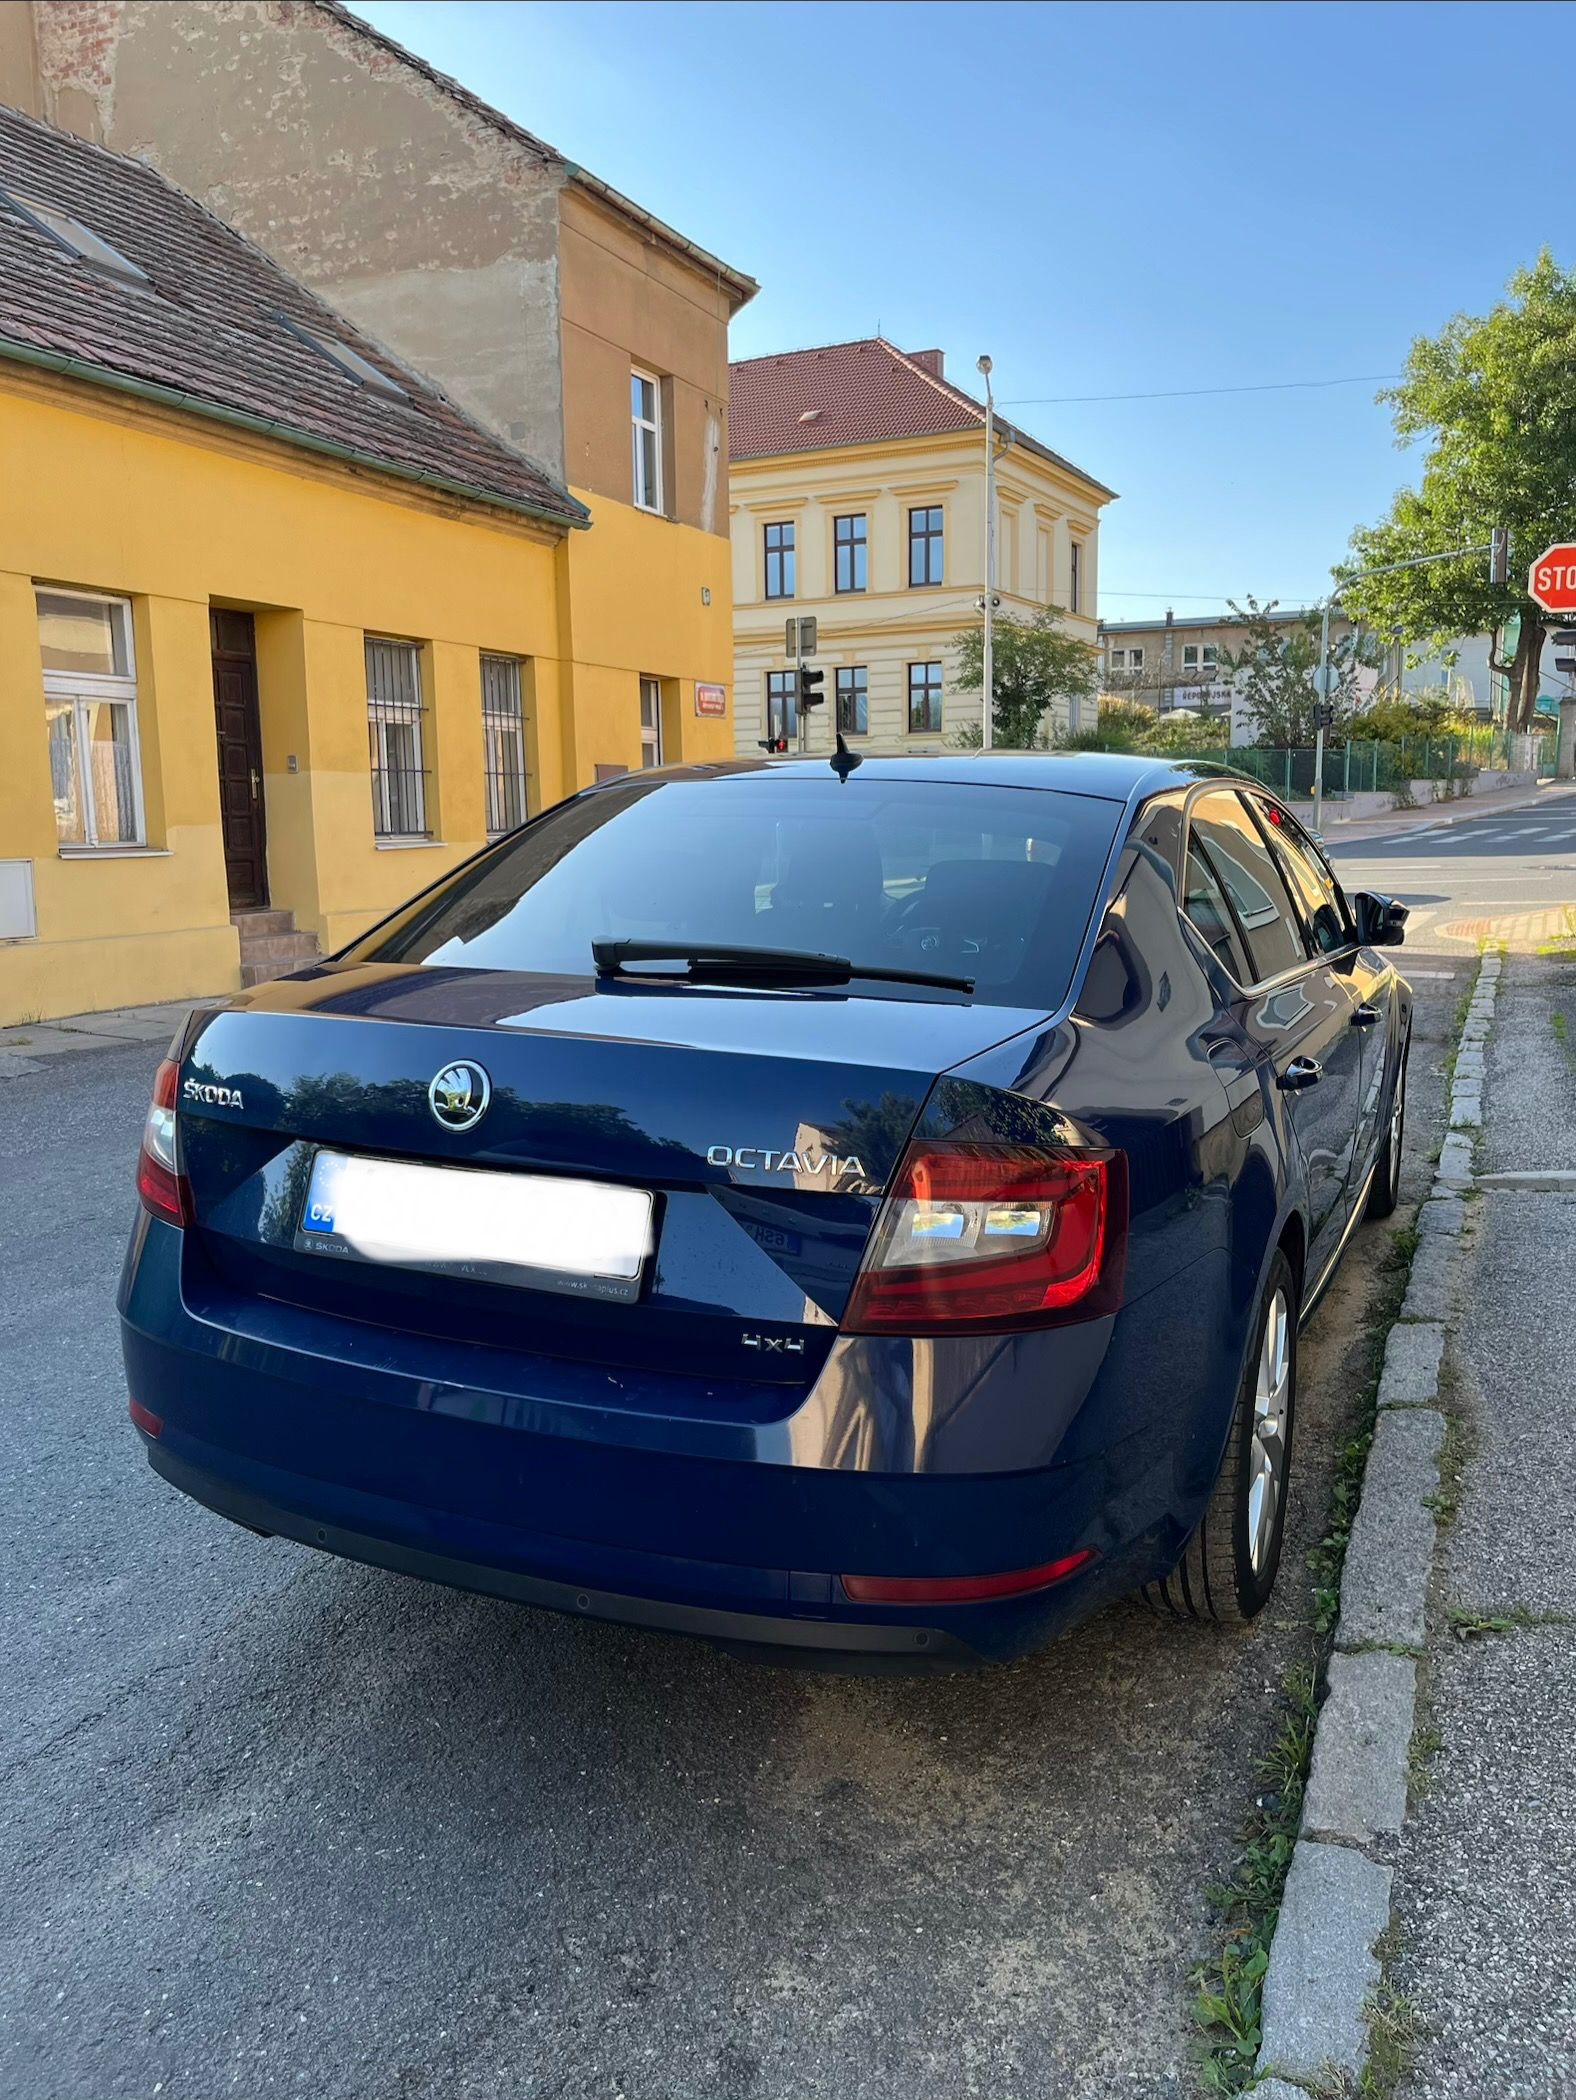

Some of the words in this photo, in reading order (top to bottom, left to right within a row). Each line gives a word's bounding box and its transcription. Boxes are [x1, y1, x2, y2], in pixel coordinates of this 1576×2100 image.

[183, 1078, 244, 1109] ŠKODA
[707, 1145, 866, 1177] OCTAVIA
[310, 1203, 333, 1223] CZ
